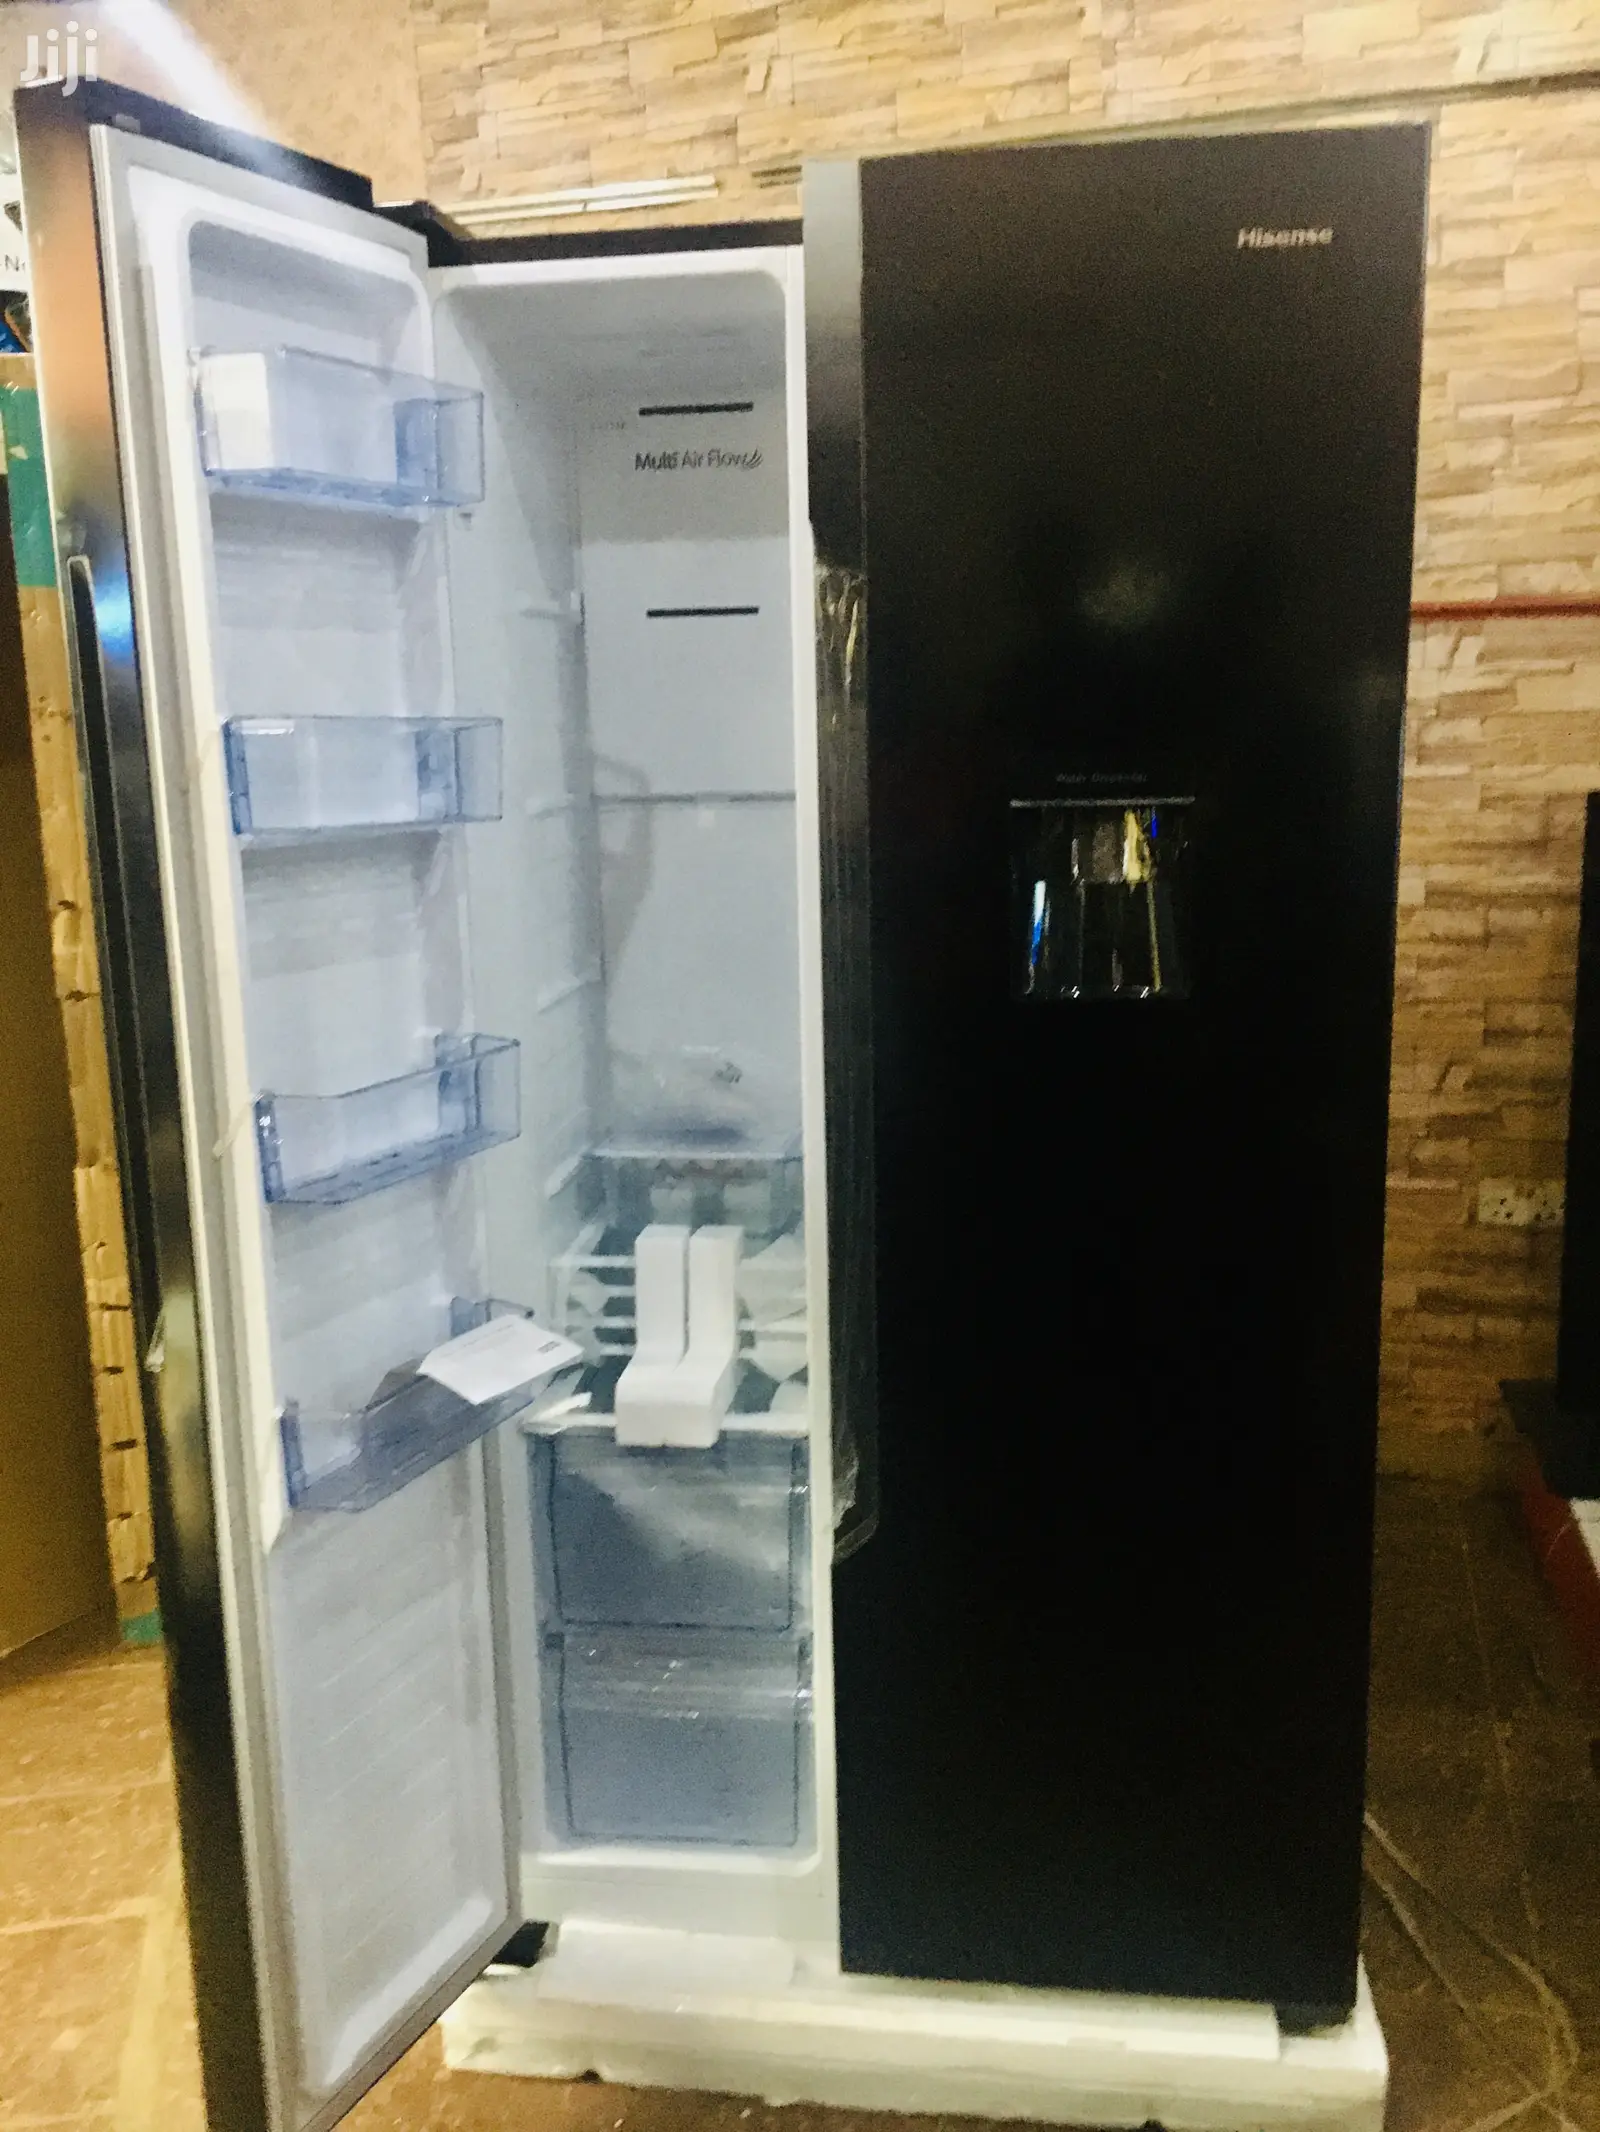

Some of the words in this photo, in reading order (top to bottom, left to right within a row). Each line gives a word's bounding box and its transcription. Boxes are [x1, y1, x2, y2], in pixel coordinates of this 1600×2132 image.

[1237, 227, 1334, 249] Hisense
[635, 451, 679, 470] Multi
[681, 449, 704, 468] Air
[707, 449, 749, 468] Flow
